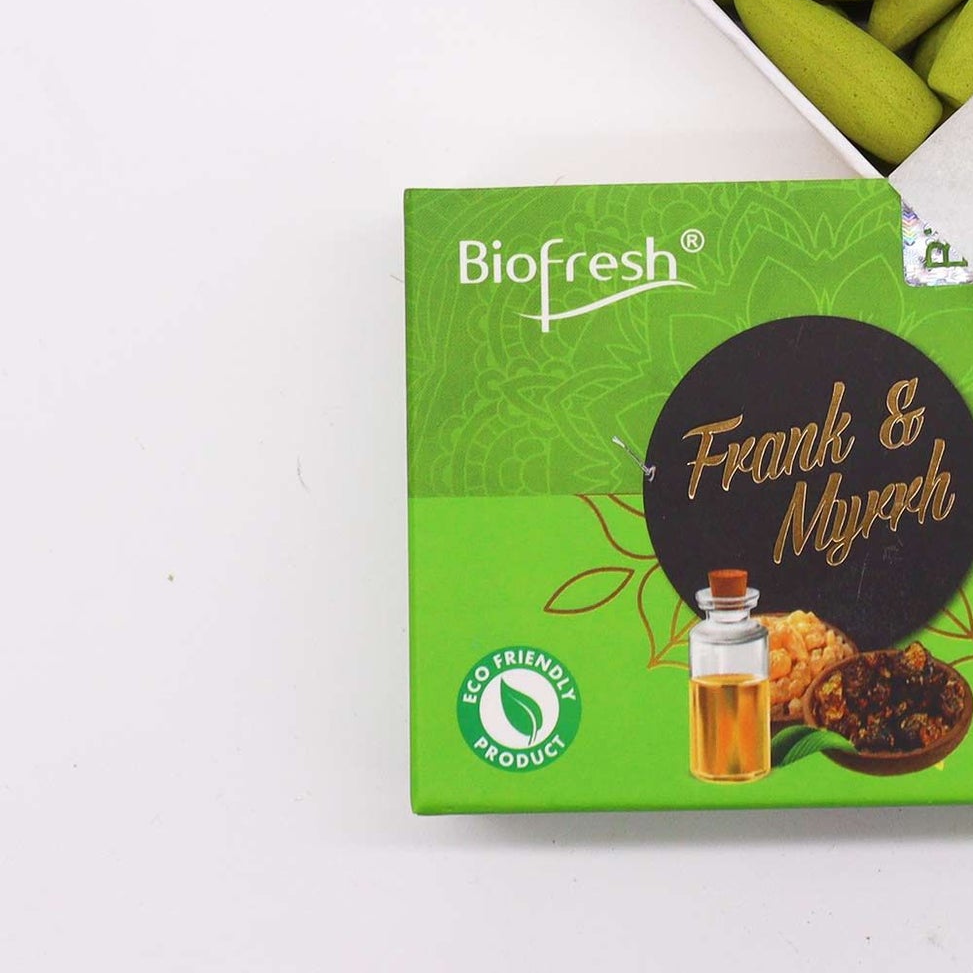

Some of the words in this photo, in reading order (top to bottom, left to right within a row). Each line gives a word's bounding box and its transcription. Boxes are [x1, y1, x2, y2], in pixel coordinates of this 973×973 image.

[682, 381, 855, 499] Frank
[879, 377, 926, 450] &
[773, 438, 955, 566] Myrrh
[462, 665, 490, 704] ECO
[492, 649, 577, 701] FRIENDLY
[473, 734, 566, 768] PRODUCT
